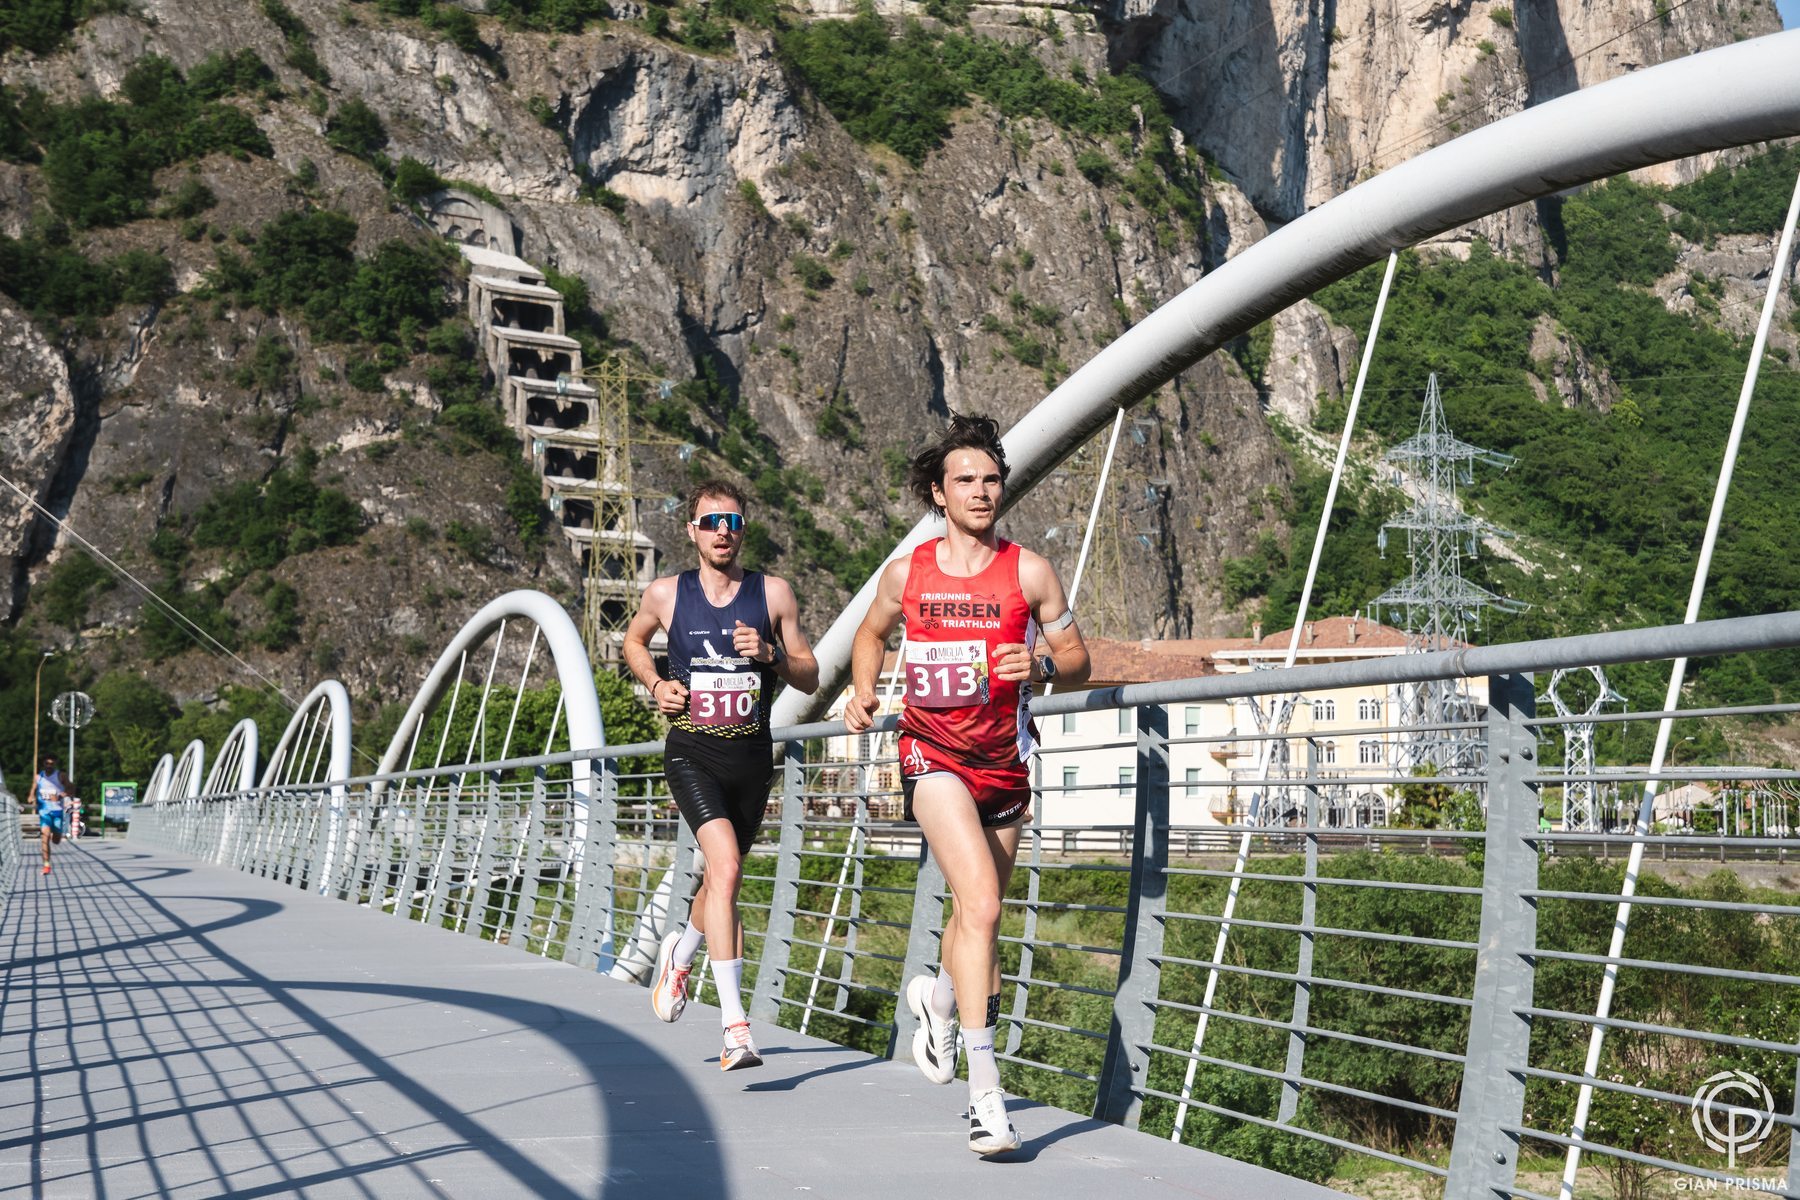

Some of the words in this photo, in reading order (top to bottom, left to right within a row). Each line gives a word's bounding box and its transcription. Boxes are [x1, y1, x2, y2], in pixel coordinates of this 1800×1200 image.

[920, 593, 972, 601] TRIRUNNIS
[919, 602, 1001, 618] FERSEN
[941, 619, 1001, 629] TRIATHLON
[913, 666, 978, 697] 313
[698, 692, 753, 718] 310
